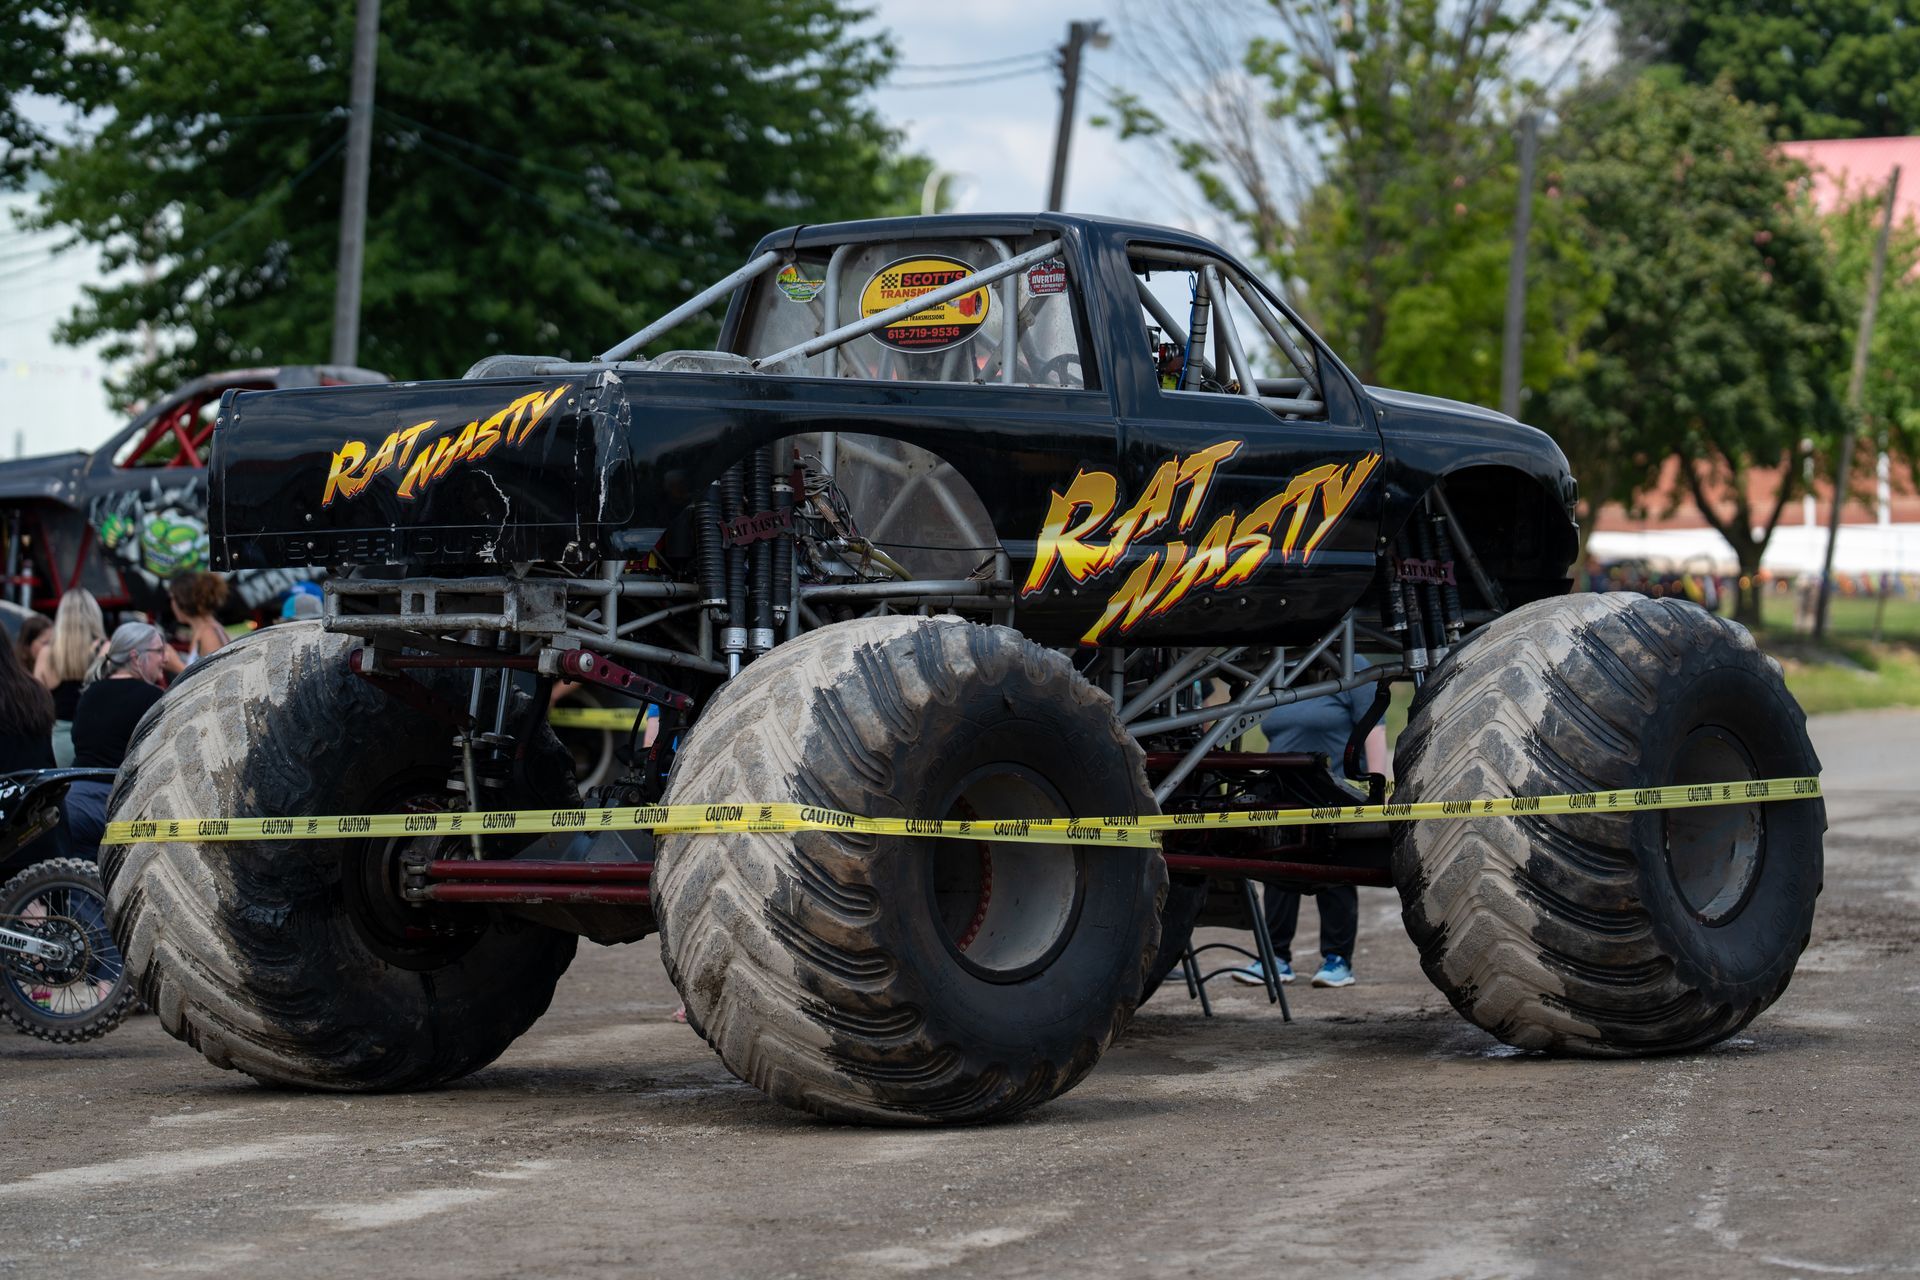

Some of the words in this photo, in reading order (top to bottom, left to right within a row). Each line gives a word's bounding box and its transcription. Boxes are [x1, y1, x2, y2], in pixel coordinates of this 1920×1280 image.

[903, 271, 964, 286] SCOTT'S
[887, 326, 960, 340] 613-719-9536
[321, 419, 438, 508] RAT
[396, 384, 573, 498] NASTY
[1021, 440, 1244, 598] RAT
[1080, 451, 1382, 647] NASTY
[130, 823, 157, 838] CAUTION
[198, 820, 229, 835] CAUTION
[261, 819, 293, 834] CAUTION
[338, 817, 371, 832] CAUTION
[405, 816, 437, 831] CAUTION
[483, 813, 516, 828] CAUTION
[552, 811, 586, 827] CAUTION
[634, 808, 669, 824] CAUTION
[705, 806, 743, 822] CAUTION
[800, 807, 855, 828] CAUTION
[906, 819, 943, 834] CAUTION
[993, 822, 1030, 837] CAUTION
[1066, 825, 1102, 840] CAUTION
[1103, 815, 1138, 826] CAUTION
[1173, 813, 1205, 824] CAUTION
[1248, 810, 1279, 821] CAUTION
[1311, 807, 1341, 819] CAUTION
[1382, 803, 1412, 816] CAUTION
[1442, 800, 1472, 814] CAUTION
[1511, 796, 1540, 811] CAUTION
[1568, 793, 1596, 808] CAUTION
[1634, 790, 1662, 805] CAUTION
[1688, 786, 1712, 802] CAUTION
[1745, 781, 1769, 797] CAUTION
[1793, 779, 1818, 794] CAUTION
